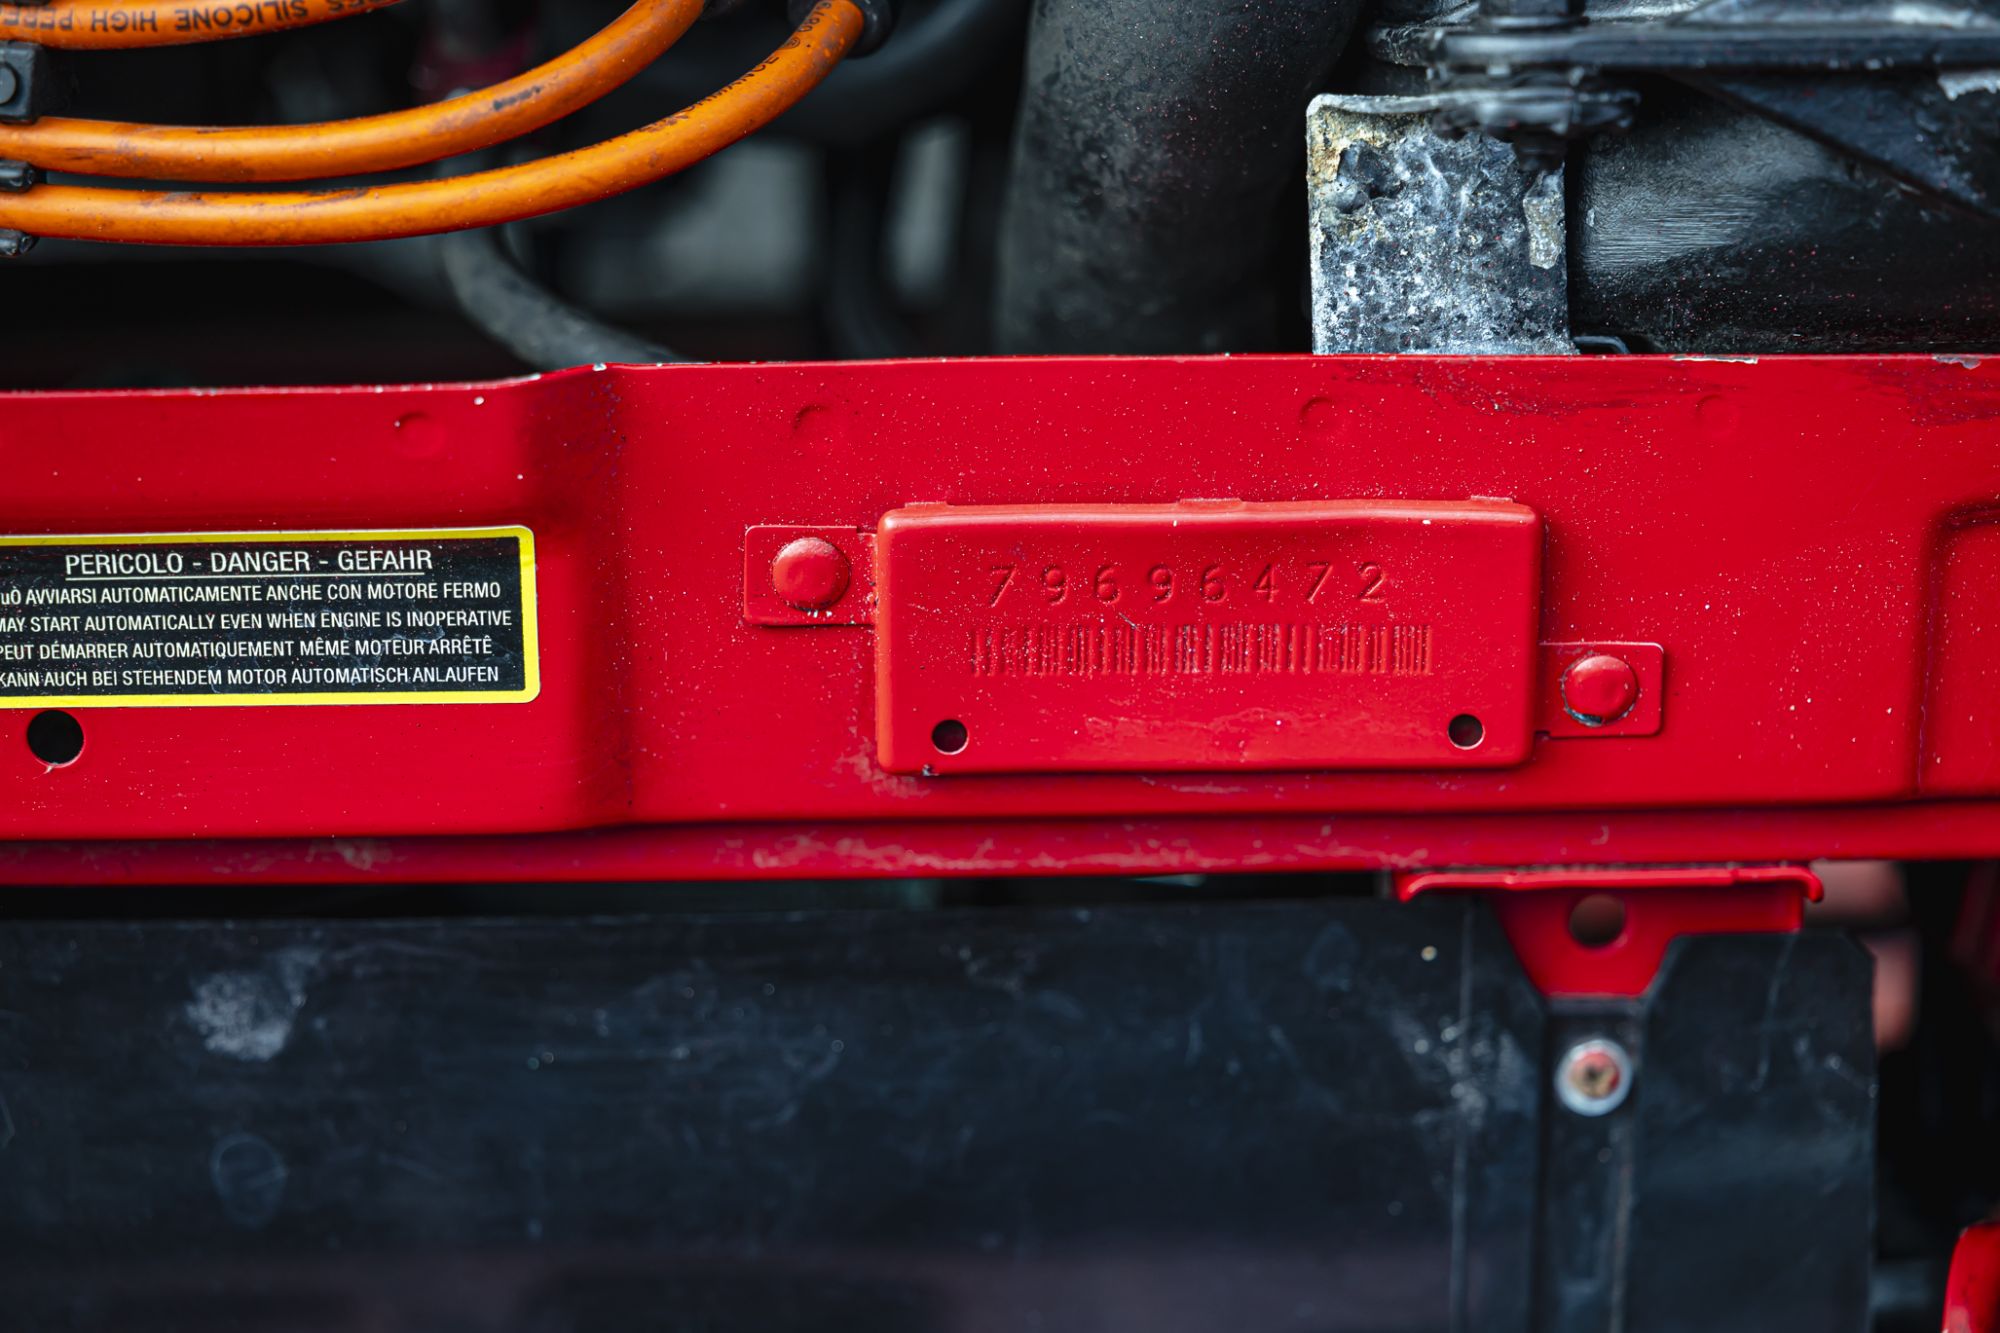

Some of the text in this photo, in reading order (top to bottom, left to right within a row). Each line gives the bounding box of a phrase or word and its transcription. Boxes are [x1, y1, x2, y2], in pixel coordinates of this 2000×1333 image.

[90, 9, 158, 32] HIGH
[174, 0, 308, 32] SILICONE
[65, 553, 183, 576] PERICOLO
[210, 552, 310, 574] DANGER
[337, 549, 433, 572] GEFAHR
[25, 588, 97, 605] AVVIARSI
[101, 585, 262, 604] AUTOMATICAMENTE
[266, 584, 322, 602] ANCHE
[327, 583, 362, 600] CON
[368, 582, 438, 600] MOTORE
[443, 581, 501, 599] FERMO
[30, 616, 80, 632] START
[84, 614, 216, 632] AUTOMATICALLY
[221, 613, 262, 630] EVEN
[266, 611, 316, 629] WHEN
[321, 611, 381, 628] ENGINE
[386, 611, 402, 628] IS
[407, 609, 513, 627] INOPERATIVE
[39, 640, 129, 660] DÉMARRER
[132, 640, 295, 660] AUTOMATIQUEMENT
[300, 636, 350, 657] MÊME
[355, 638, 424, 656] MOTEUR
[44, 671, 88, 687] AUCH
[92, 670, 118, 687] BEI
[122, 669, 222, 686] STEHENDEM
[227, 668, 288, 685] MOTOR
[291, 666, 408, 684] AUTOMATISCH
[412, 666, 499, 683] ANLAUFEN
